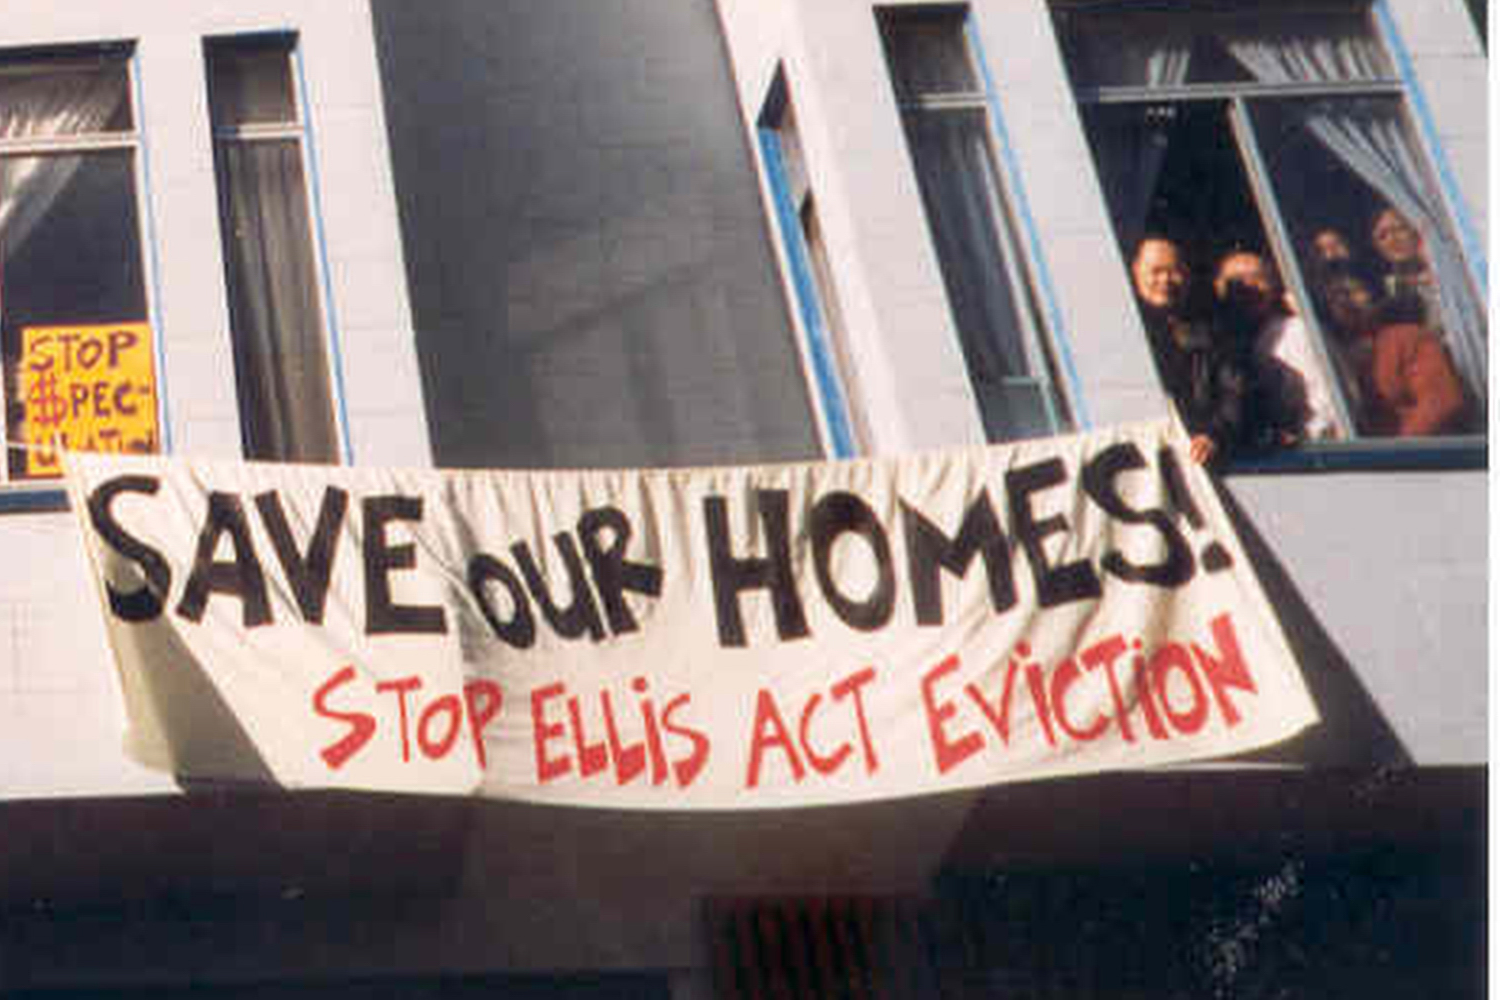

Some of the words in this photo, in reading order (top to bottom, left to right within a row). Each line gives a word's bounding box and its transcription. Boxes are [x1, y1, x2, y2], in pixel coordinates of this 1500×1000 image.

[30, 332, 138, 372] STOP
[87, 474, 448, 636] SAVE
[466, 505, 664, 650] OUR
[701, 442, 1233, 650] HOMES!
[312, 664, 502, 770] STOP
[744, 667, 880, 790] ACT
